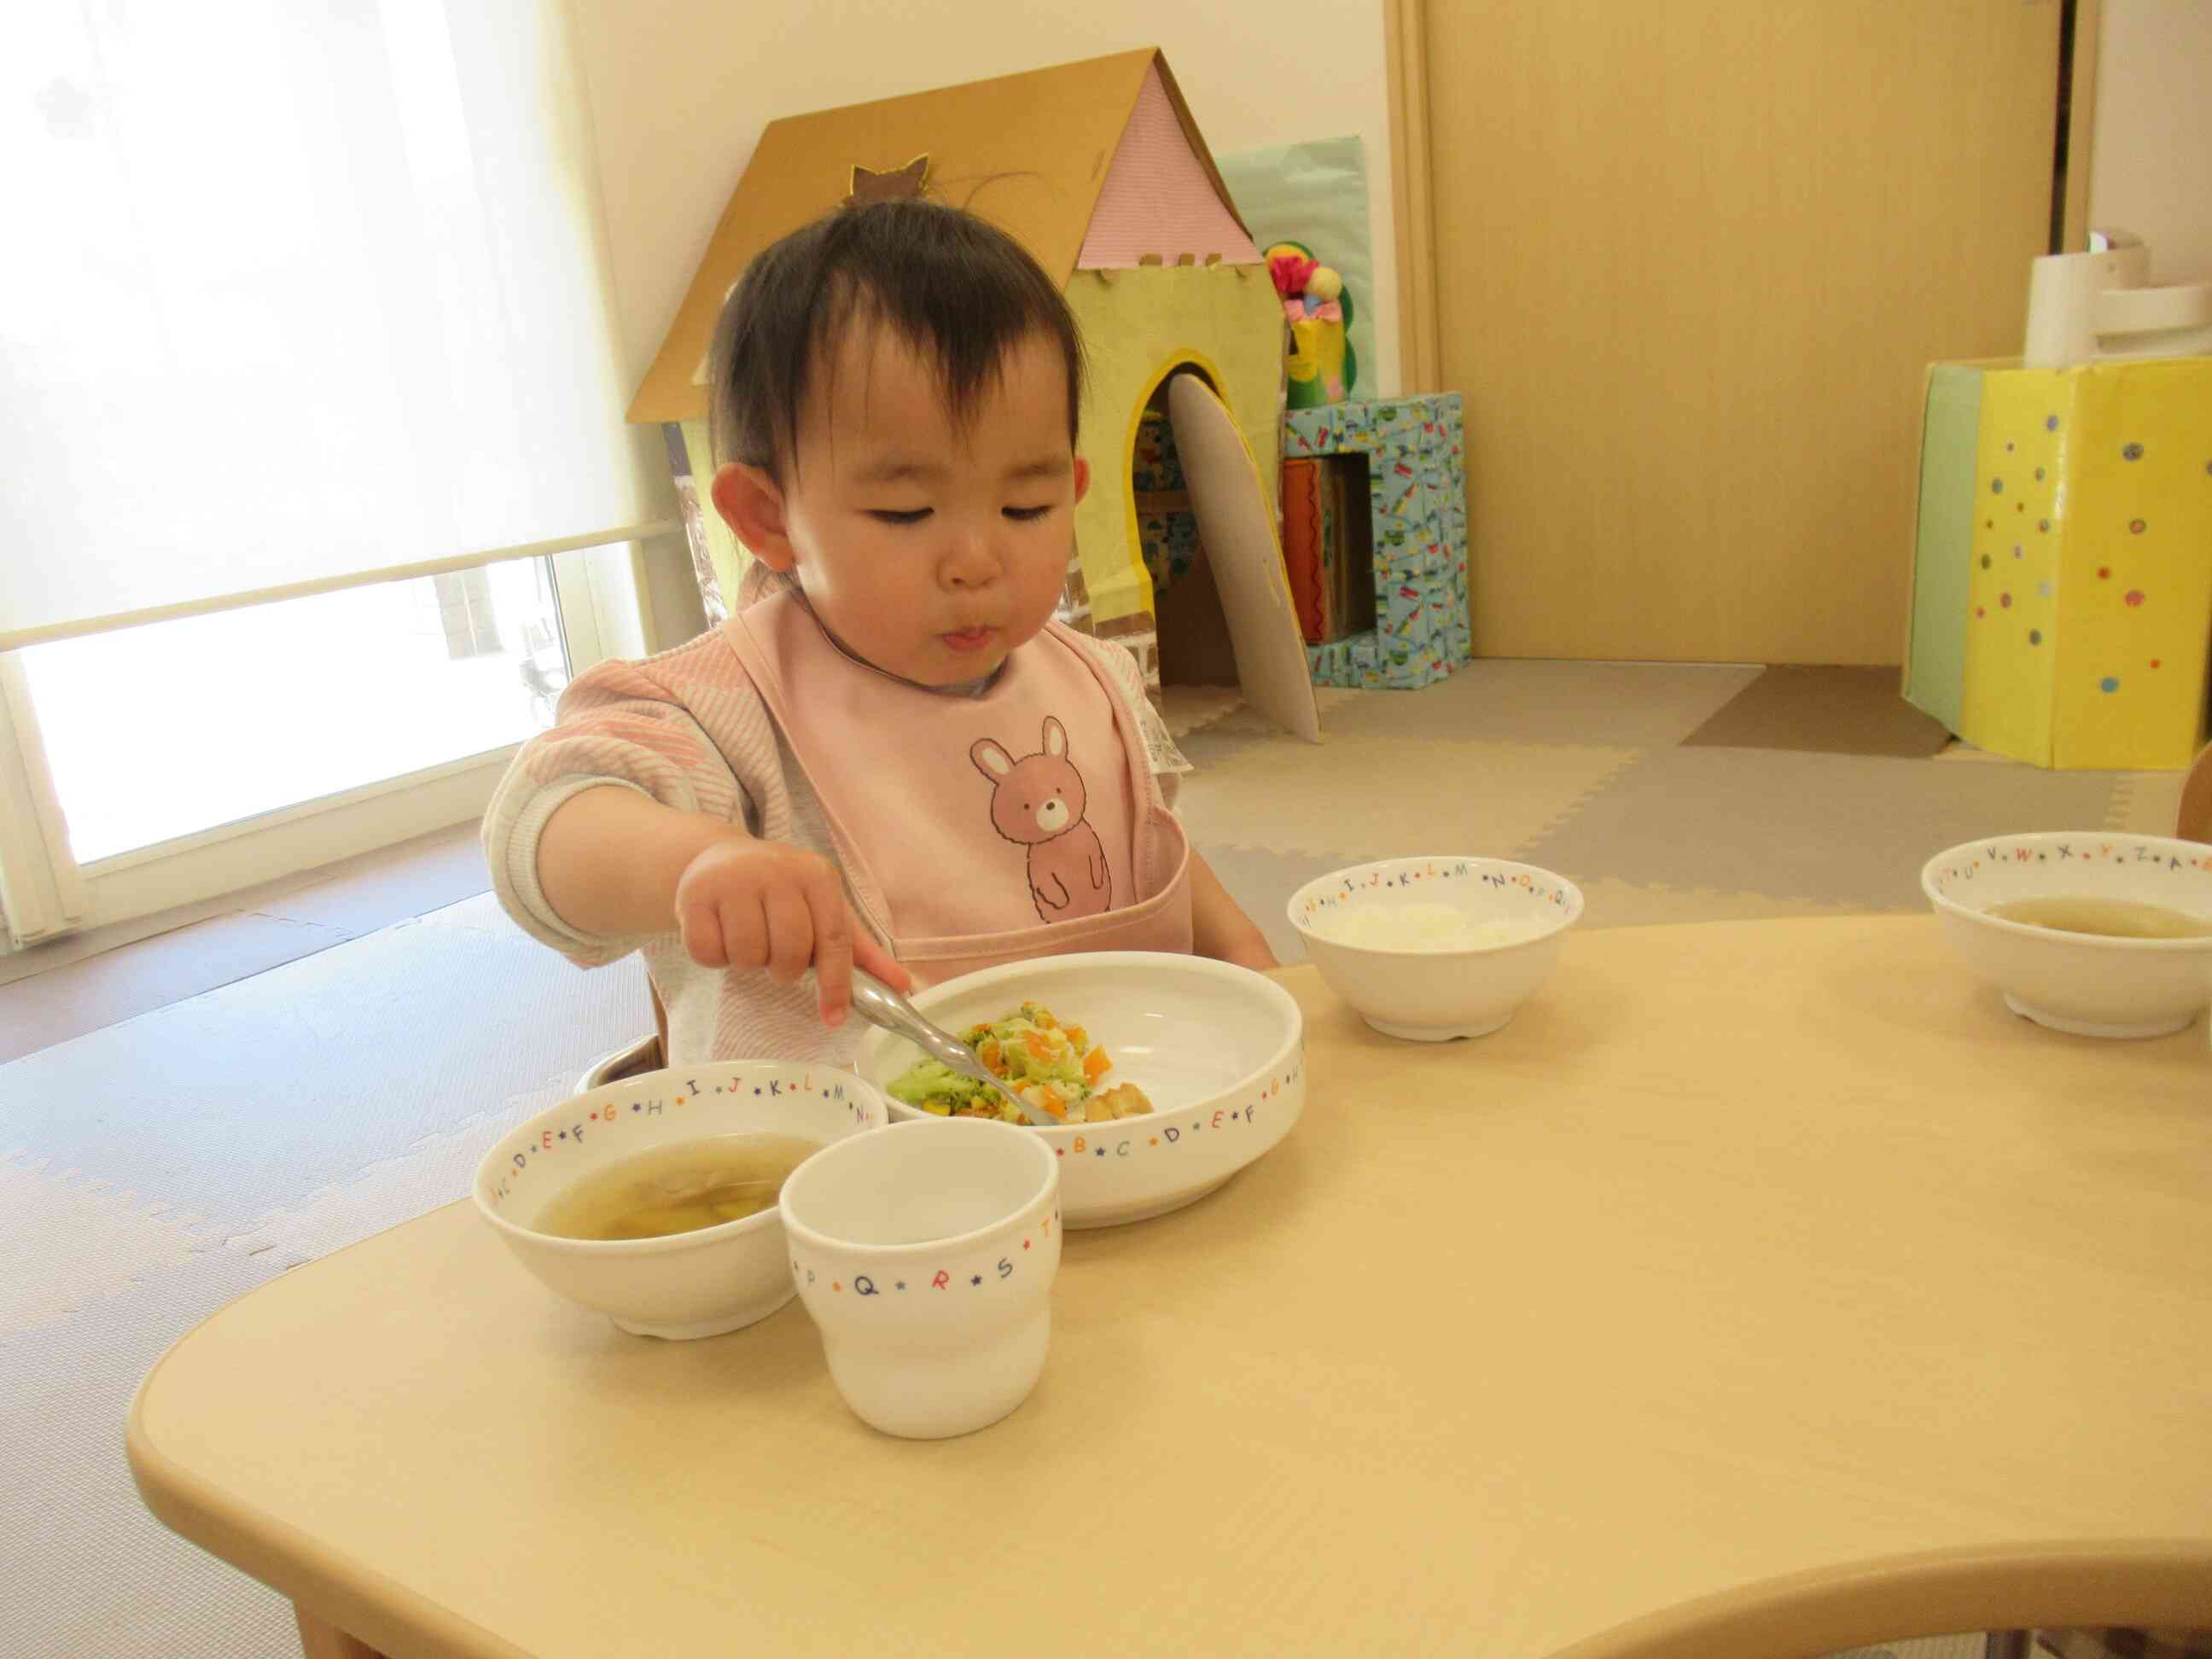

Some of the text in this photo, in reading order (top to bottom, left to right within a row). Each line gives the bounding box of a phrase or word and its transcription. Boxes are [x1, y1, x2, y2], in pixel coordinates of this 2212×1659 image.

[1369, 873, 1380, 888] J
[1400, 872, 1411, 888] K
[1455, 862, 1468, 876] M
[1492, 874, 1505, 888] N
[1519, 874, 1529, 888] O
[2014, 847, 2033, 861] W
[2058, 843, 2072, 859] X
[2170, 855, 2183, 871] A
[514, 1153, 527, 1169] D
[541, 1131, 553, 1150] E
[573, 1125, 585, 1144] F
[603, 1105, 616, 1121] G
[648, 1099, 662, 1115] H
[686, 1080, 701, 1097] I
[728, 1076, 742, 1093] J
[770, 1079, 783, 1097] K
[804, 1074, 813, 1091] L
[833, 1083, 845, 1100] M
[1074, 1135, 1086, 1154] B
[1117, 1140, 1131, 1156] C
[1164, 1126, 1180, 1144] D
[1212, 1110, 1225, 1129] E
[1245, 1104, 1255, 1124] F
[854, 1275, 880, 1296] Q
[931, 1269, 950, 1291] R
[997, 1256, 1013, 1280] S
